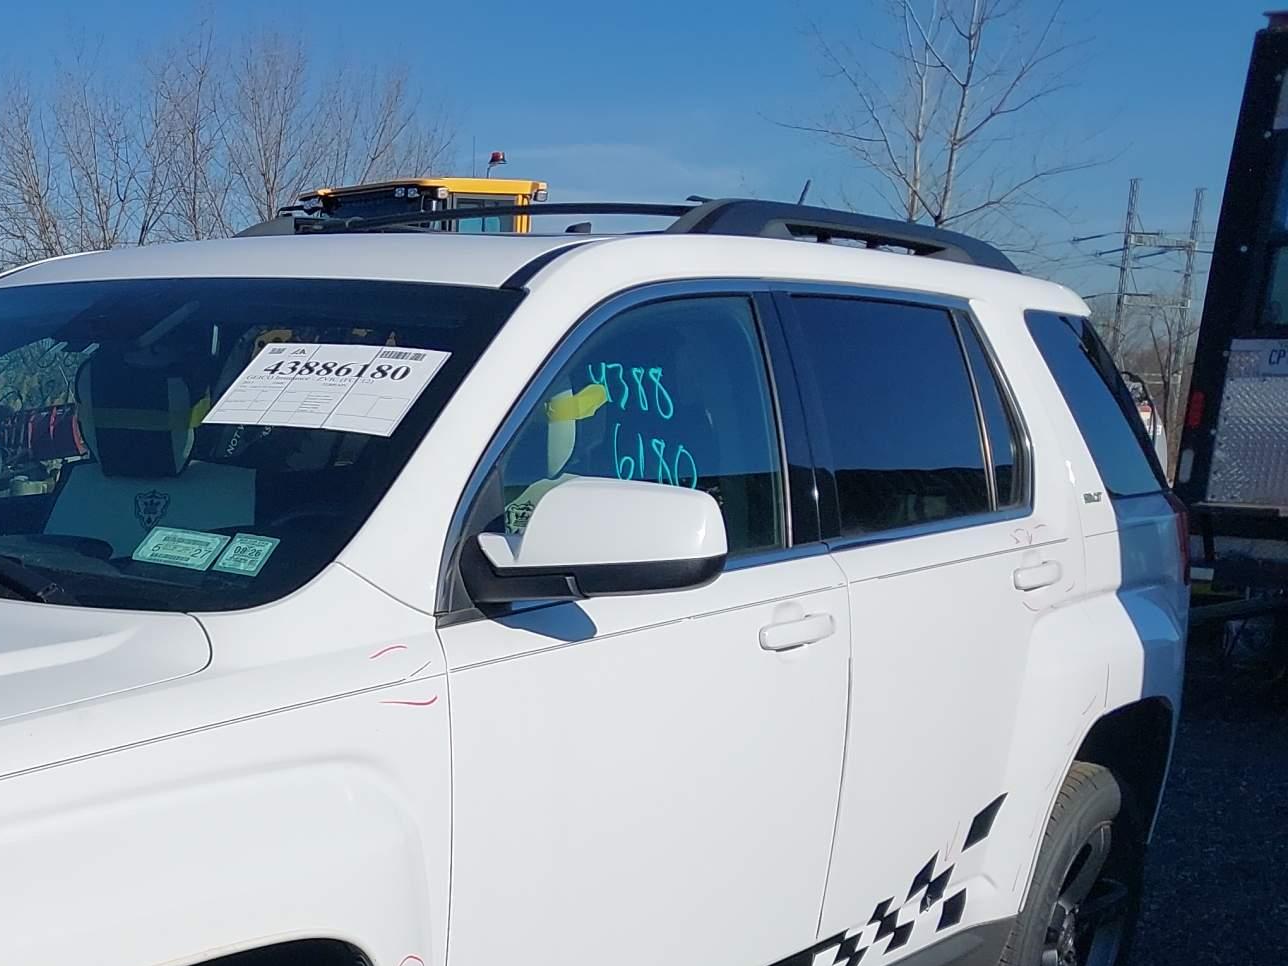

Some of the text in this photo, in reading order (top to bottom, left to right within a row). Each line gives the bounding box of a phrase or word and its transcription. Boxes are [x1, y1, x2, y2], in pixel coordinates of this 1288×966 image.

[263, 359, 412, 381] 43886180
[589, 362, 674, 420] 4388
[614, 423, 698, 489] 6180
